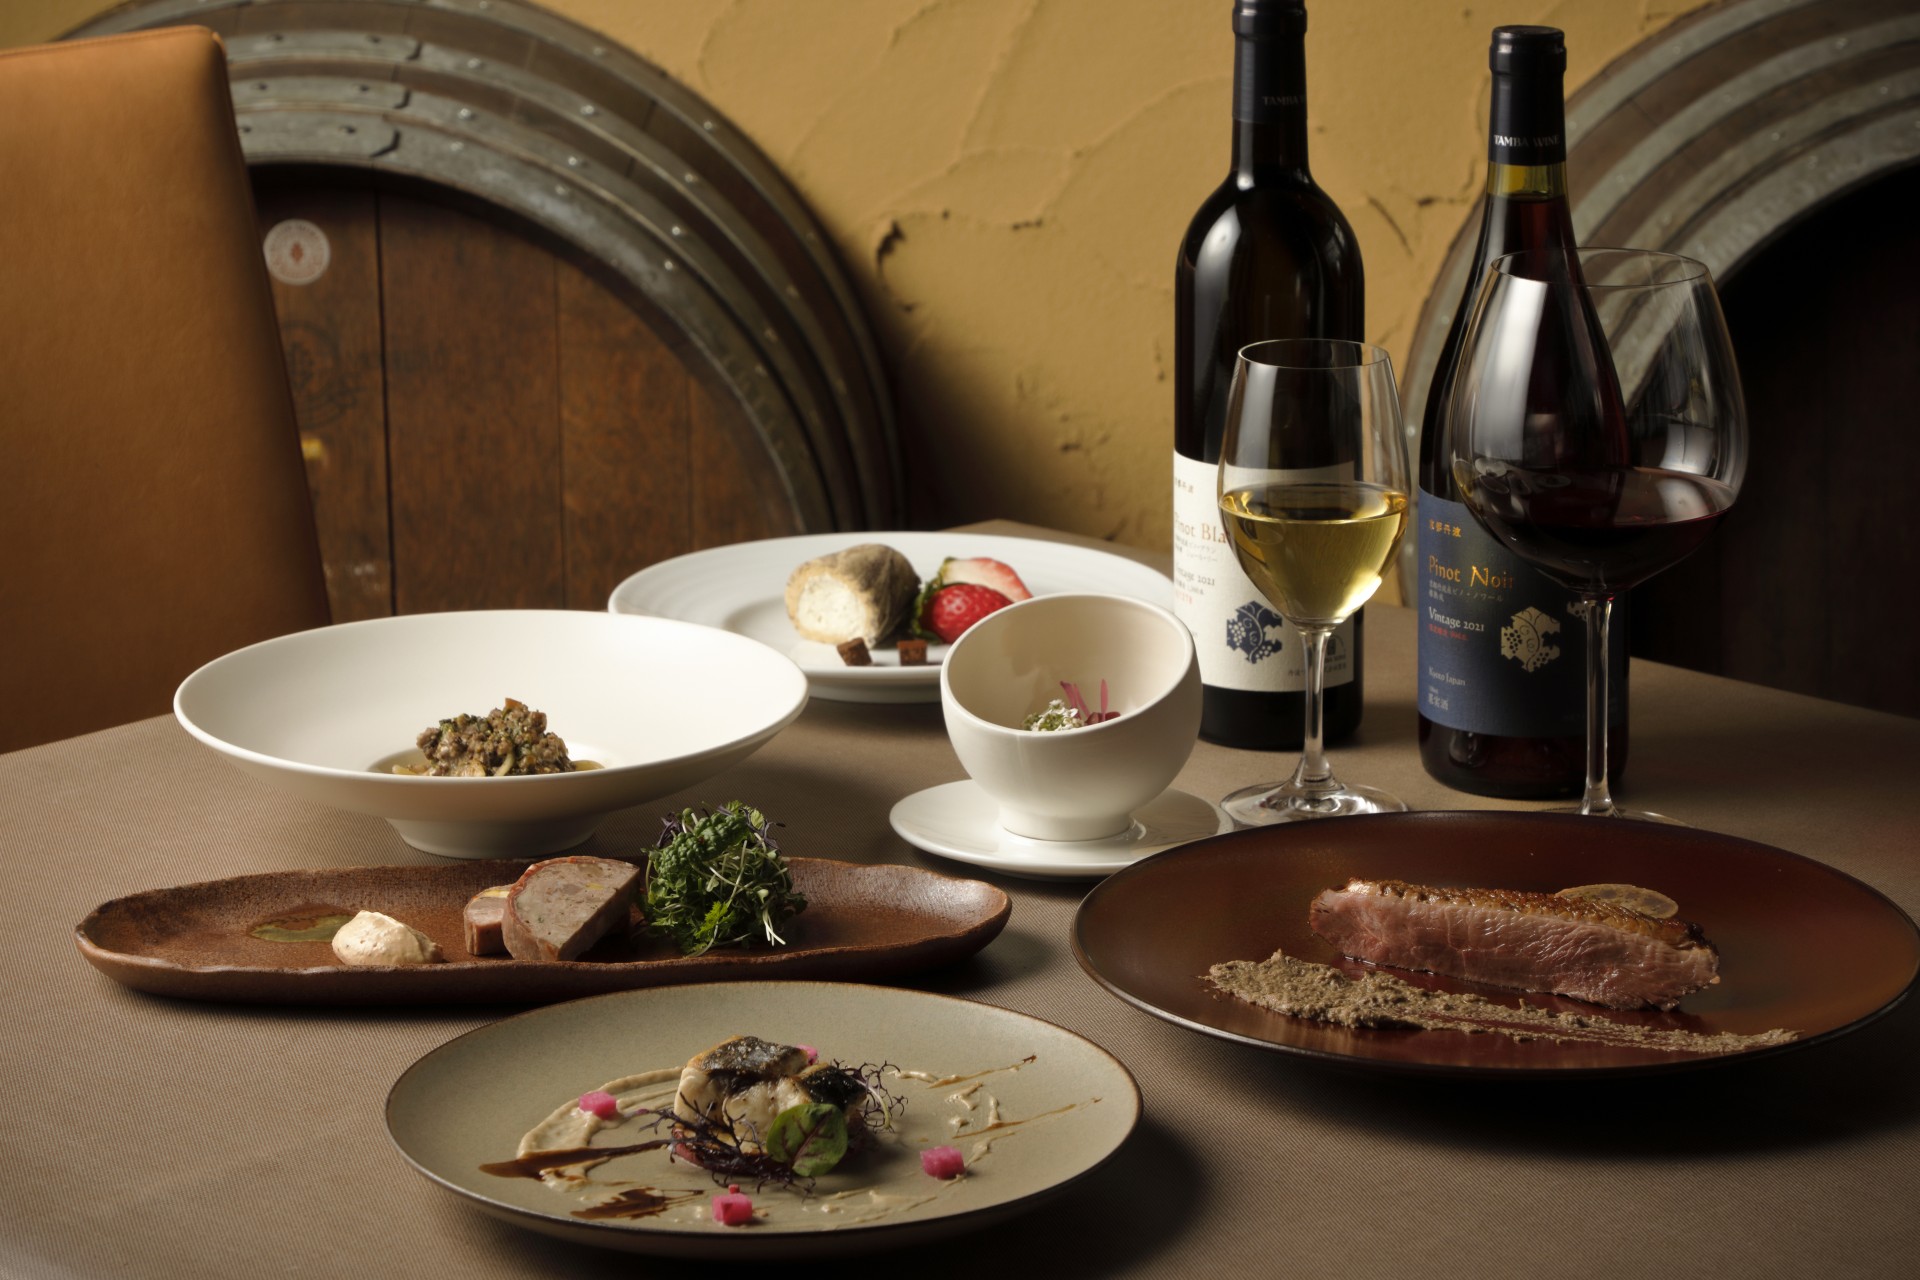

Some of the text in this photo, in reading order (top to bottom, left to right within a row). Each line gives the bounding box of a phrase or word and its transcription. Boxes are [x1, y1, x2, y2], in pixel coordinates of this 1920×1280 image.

[1494, 134, 1560, 147] TAMBA WINE
[1198, 574, 1215, 586] 2021
[1429, 554, 1514, 592] Pinot Noir
[1428, 606, 1461, 628] Vintage
[1463, 621, 1485, 632] 2021
